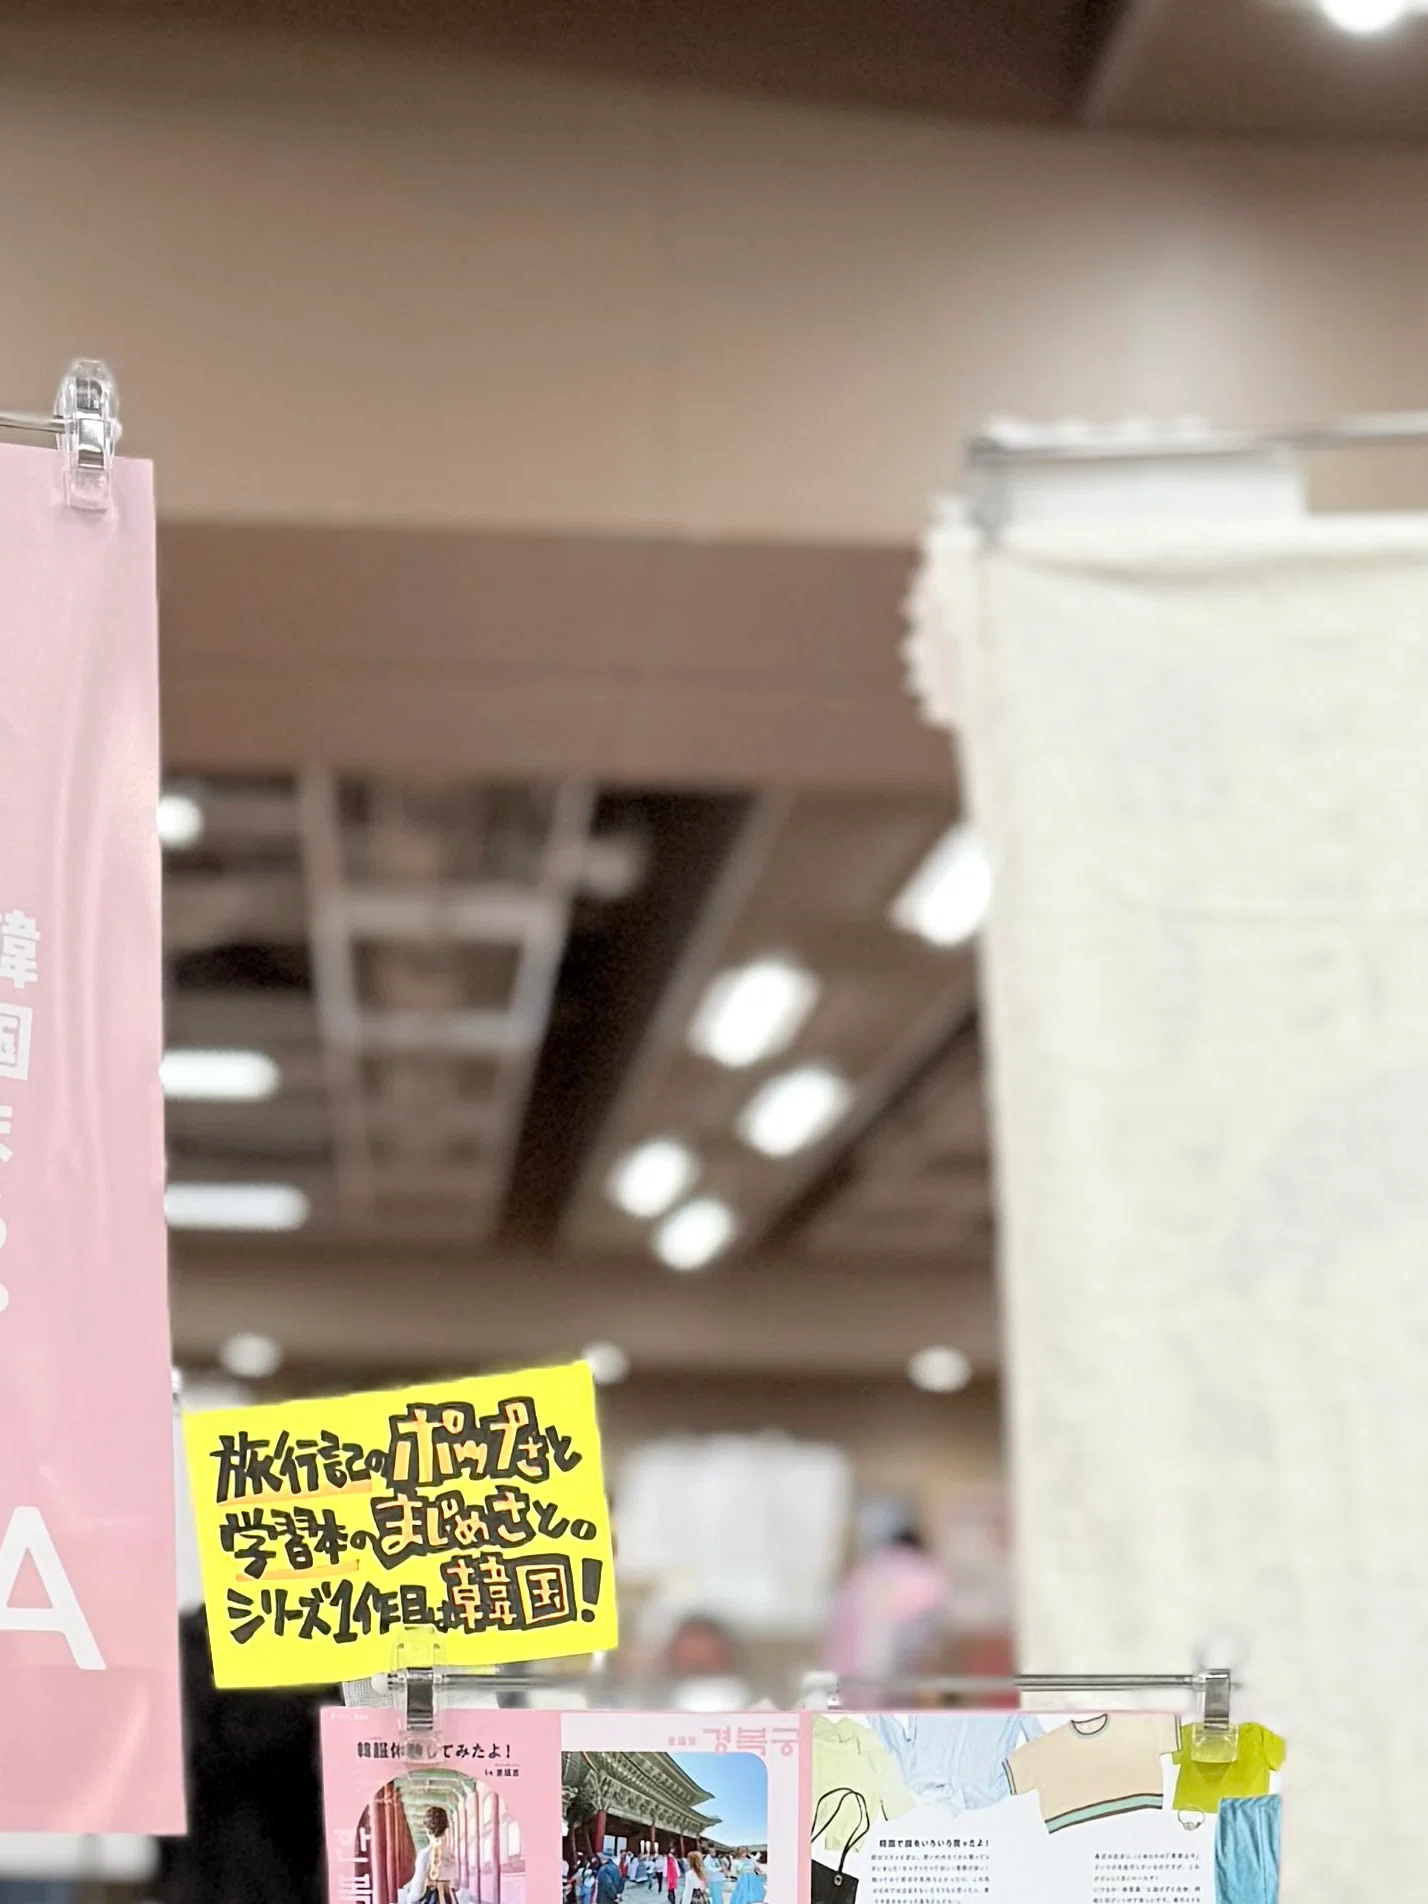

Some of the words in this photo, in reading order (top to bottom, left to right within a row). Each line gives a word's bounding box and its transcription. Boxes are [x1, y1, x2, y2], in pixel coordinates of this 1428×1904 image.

[211, 1396, 581, 1503] 旅行記のポップさと
[220, 1486, 596, 1578] 学習本のまじめさと。
